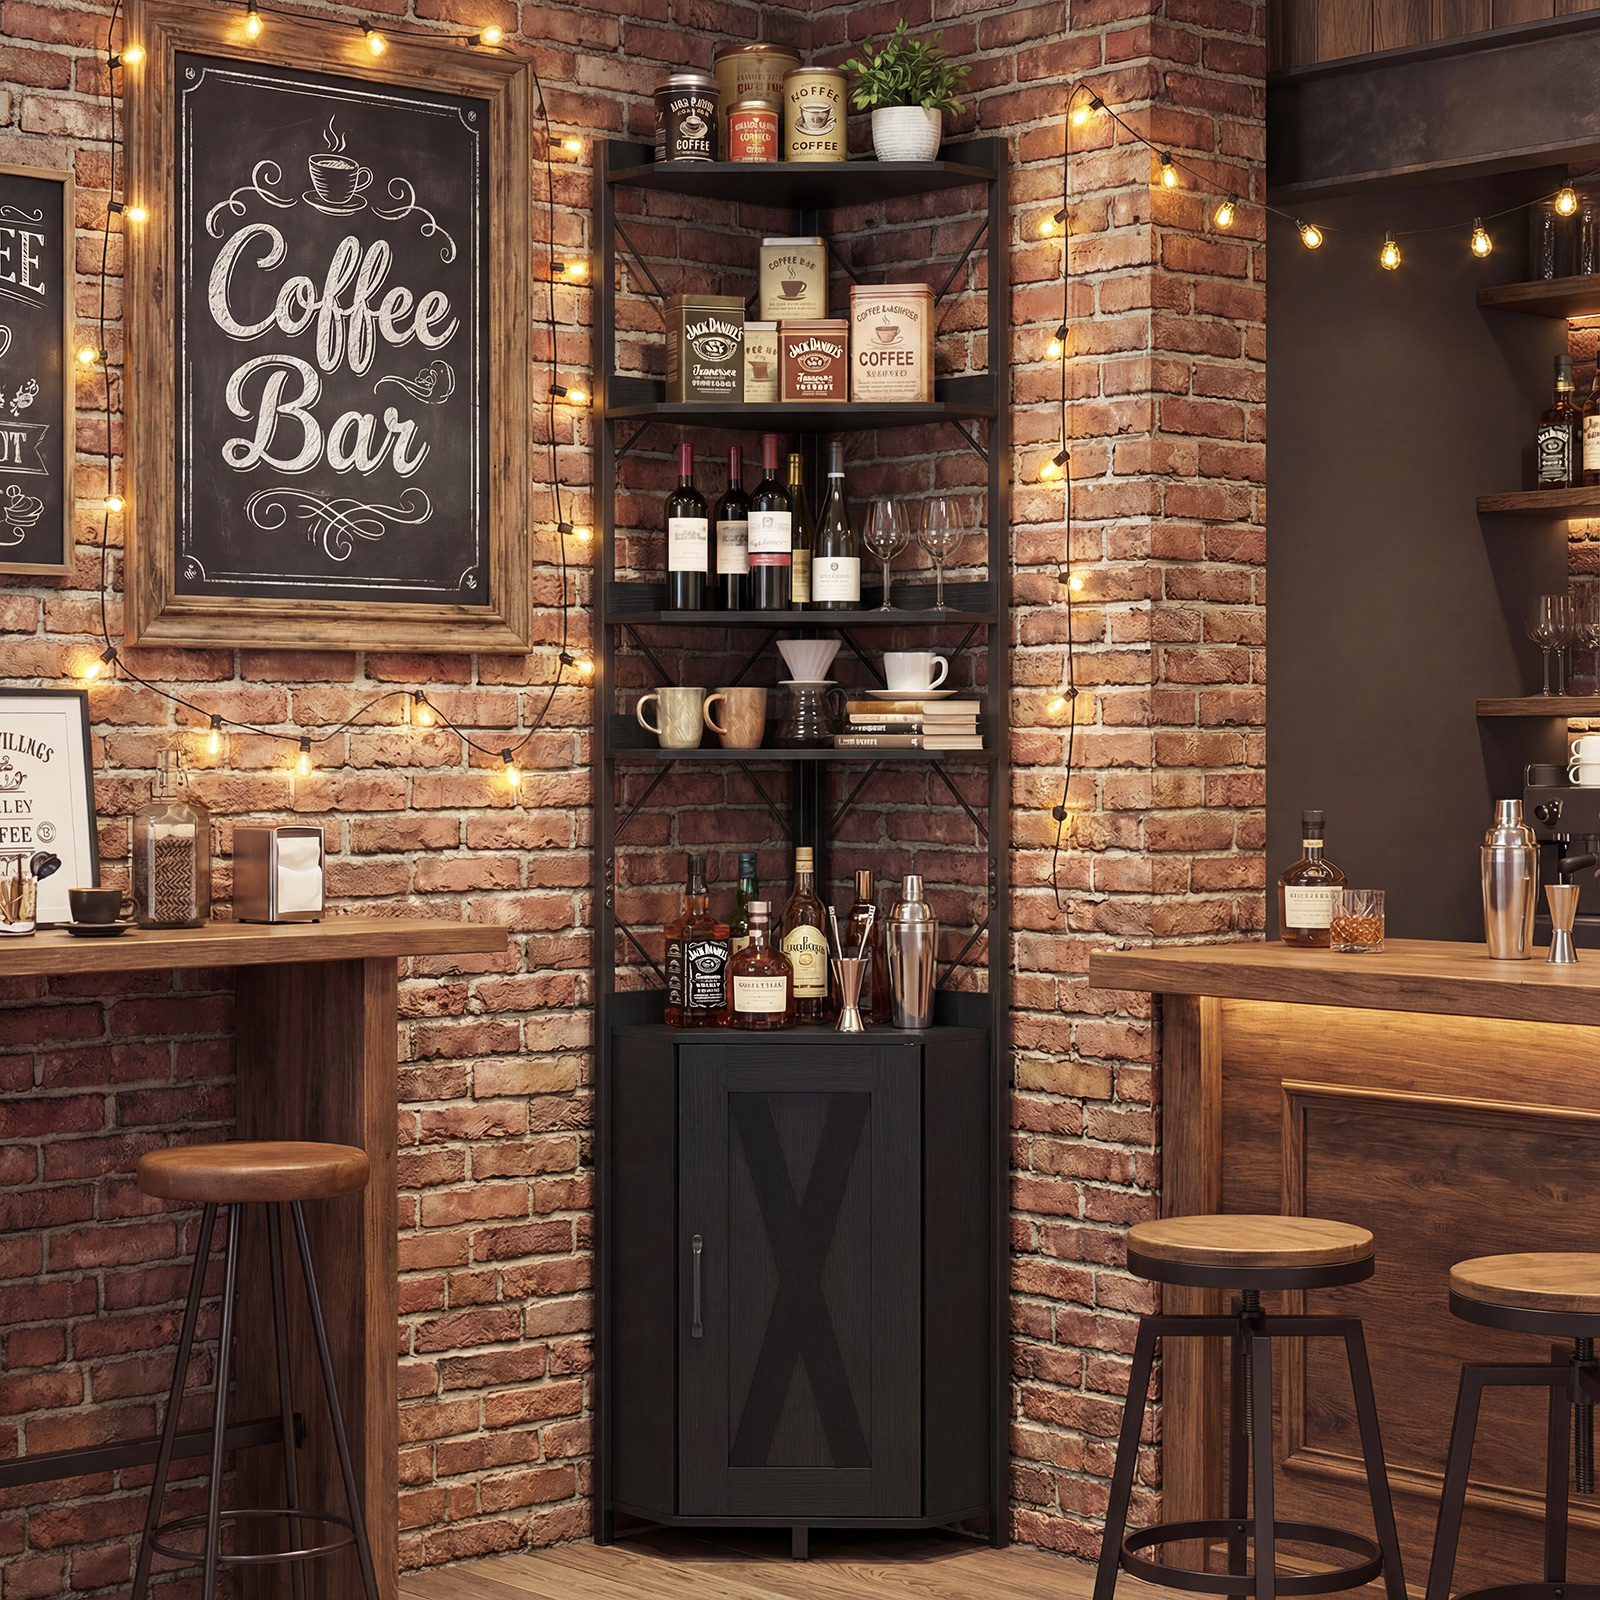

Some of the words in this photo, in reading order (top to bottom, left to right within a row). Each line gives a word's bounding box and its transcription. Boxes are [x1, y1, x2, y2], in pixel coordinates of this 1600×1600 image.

[676, 139, 710, 151] COFFEE
[792, 141, 838, 151] COFFEE
[768, 256, 798, 271] COFFEE
[208, 223, 460, 376] Coffee
[859, 351, 914, 367] COFFEE
[222, 354, 430, 477] Bar
